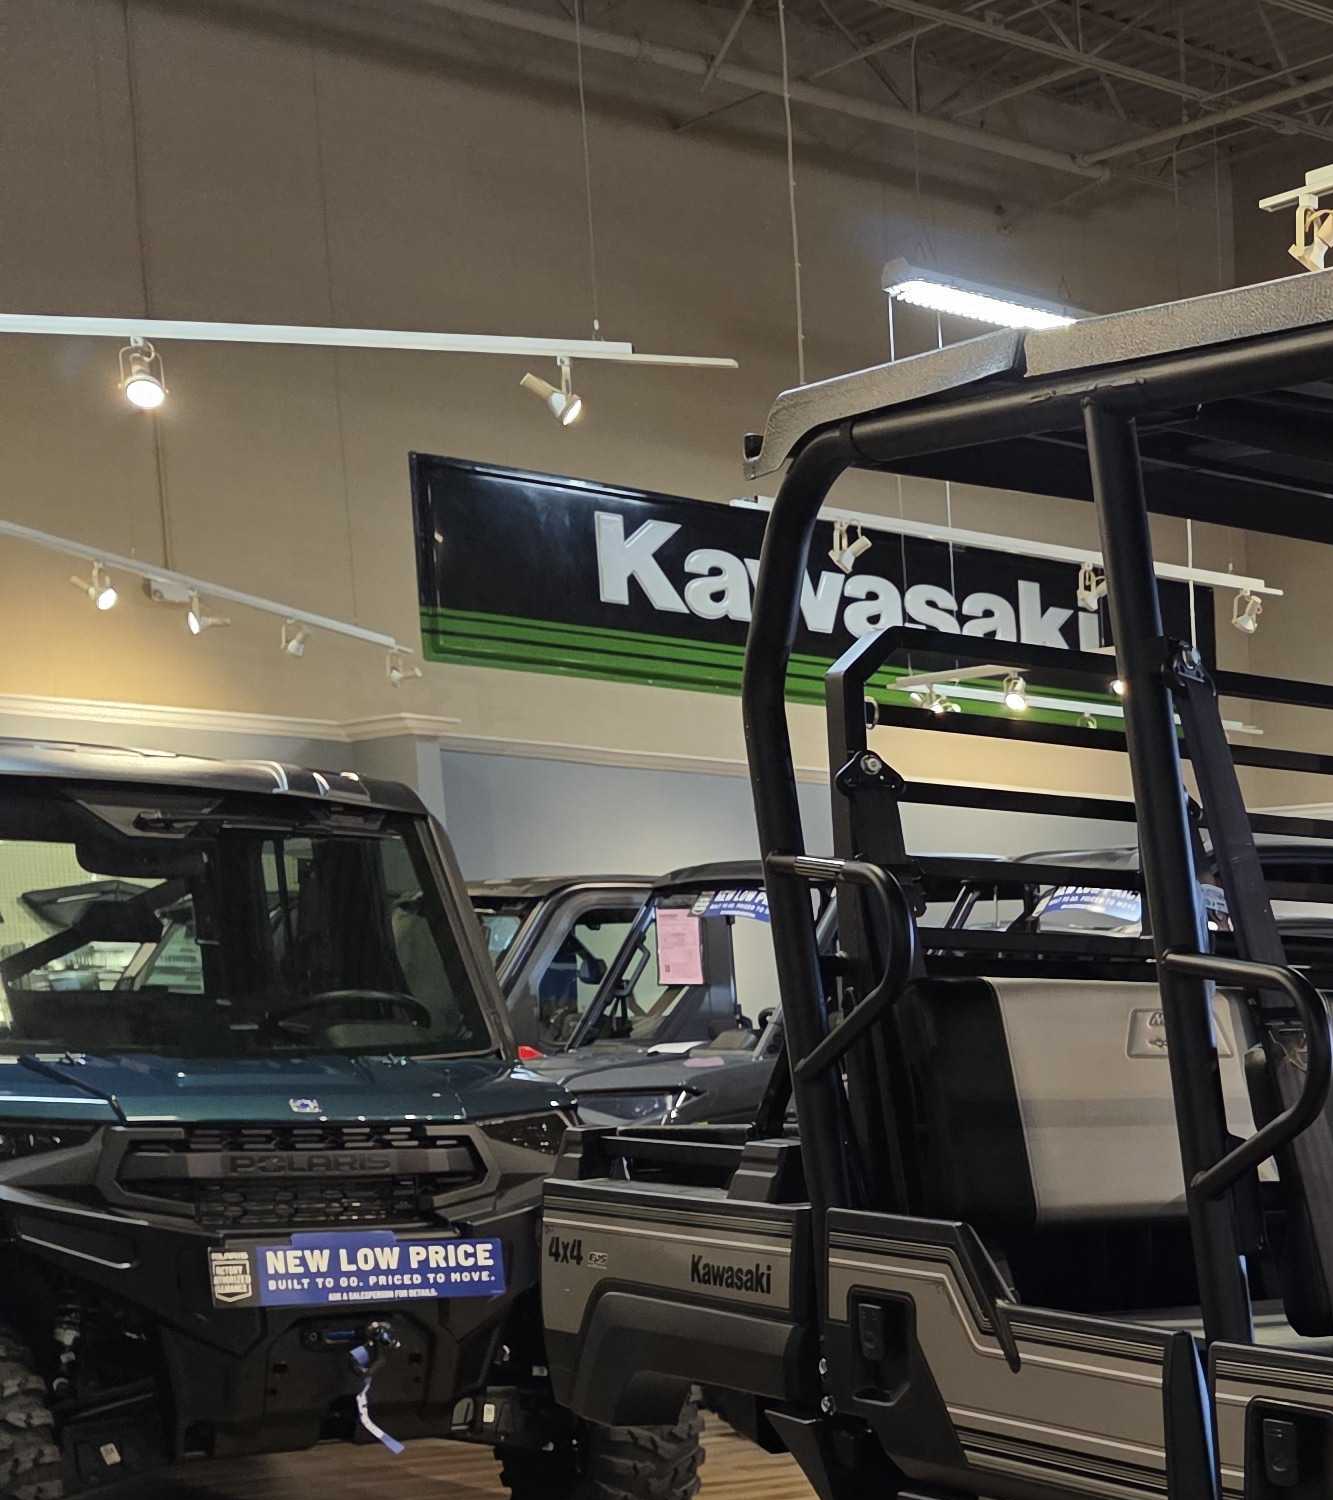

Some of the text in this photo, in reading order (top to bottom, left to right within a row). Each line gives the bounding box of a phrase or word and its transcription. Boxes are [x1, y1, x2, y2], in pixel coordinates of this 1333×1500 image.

[266, 1243, 495, 1275] NEW LOW PRICE
[548, 1236, 583, 1266] 4x4
[268, 1278, 310, 1291] BUILT
[316, 1277, 334, 1289] TO
[369, 1274, 422, 1287] PRICED
[428, 1273, 446, 1285] TO
[450, 1271, 496, 1283] MOVE.
[690, 1254, 771, 1295] Kawasaki
